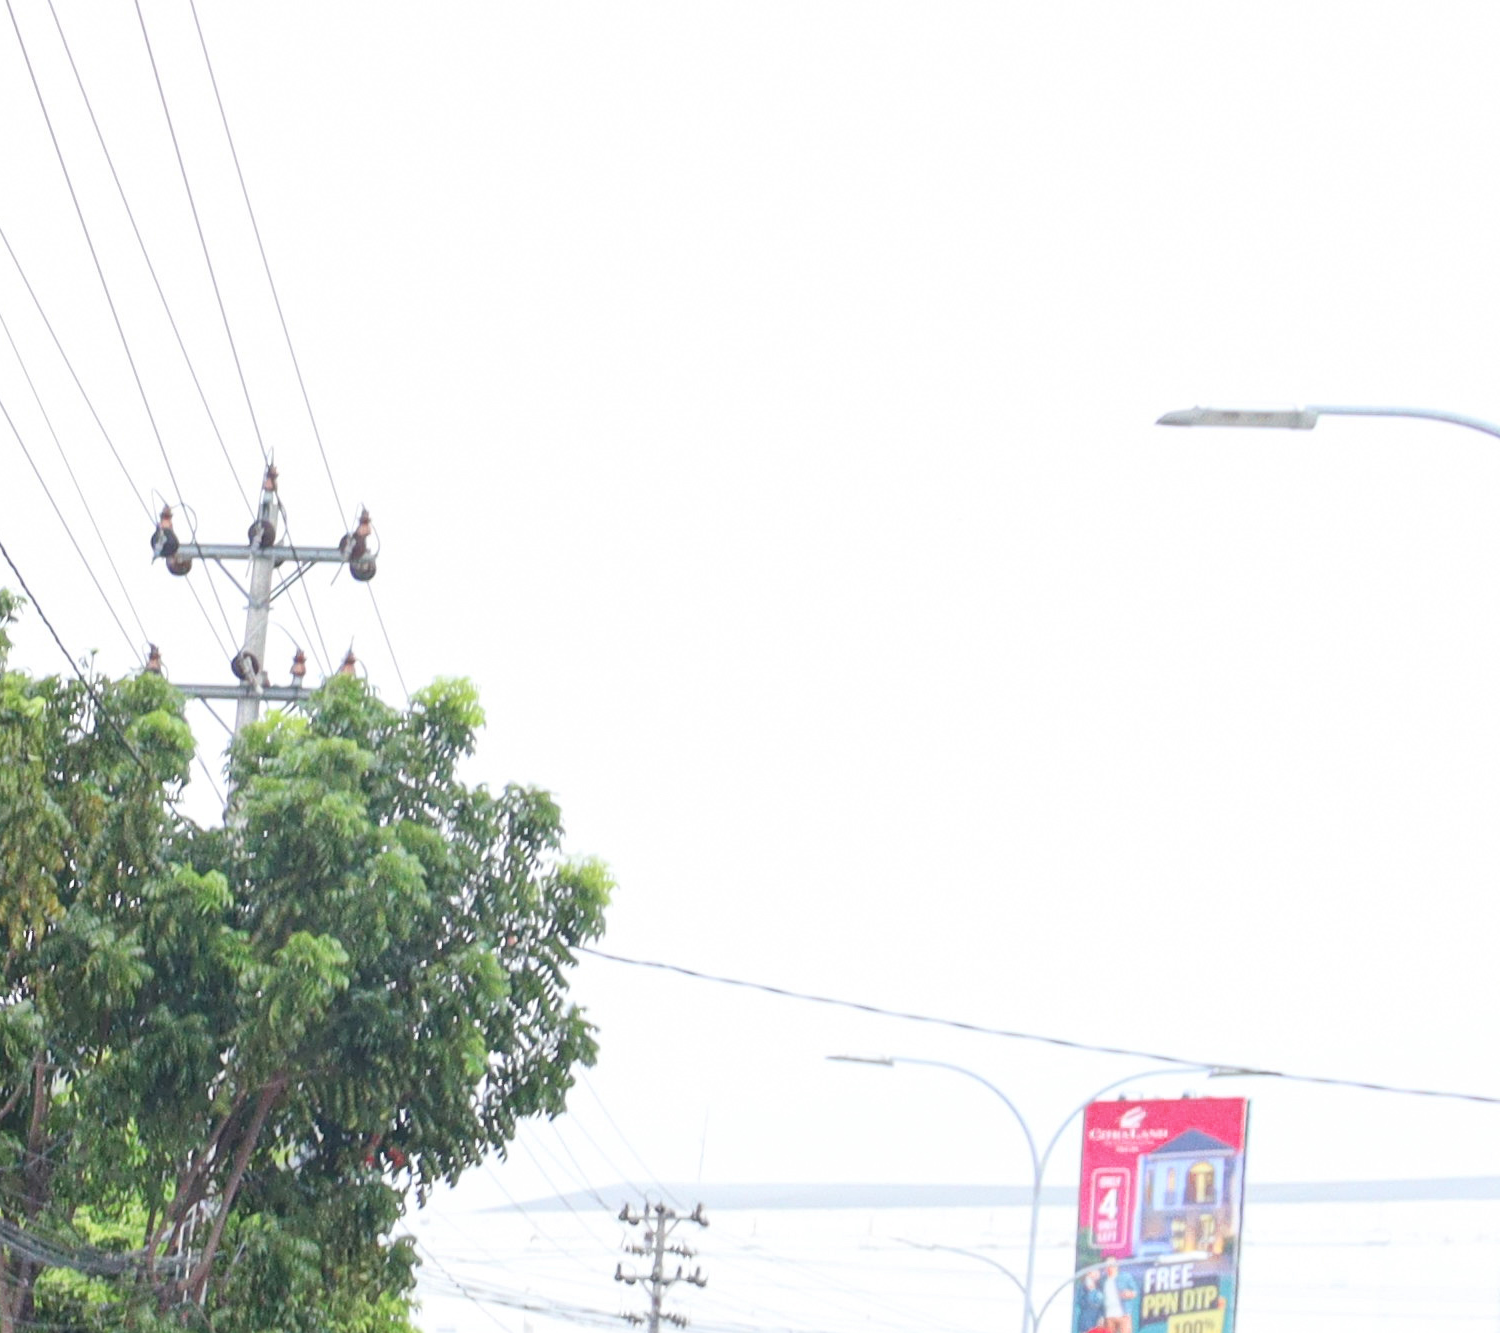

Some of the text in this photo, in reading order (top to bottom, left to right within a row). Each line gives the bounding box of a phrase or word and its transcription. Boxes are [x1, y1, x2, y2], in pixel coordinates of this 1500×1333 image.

[1098, 1188, 1118, 1219] 4
[1144, 1263, 1194, 1293] FREE
[1141, 1285, 1218, 1319] PPN DTP
